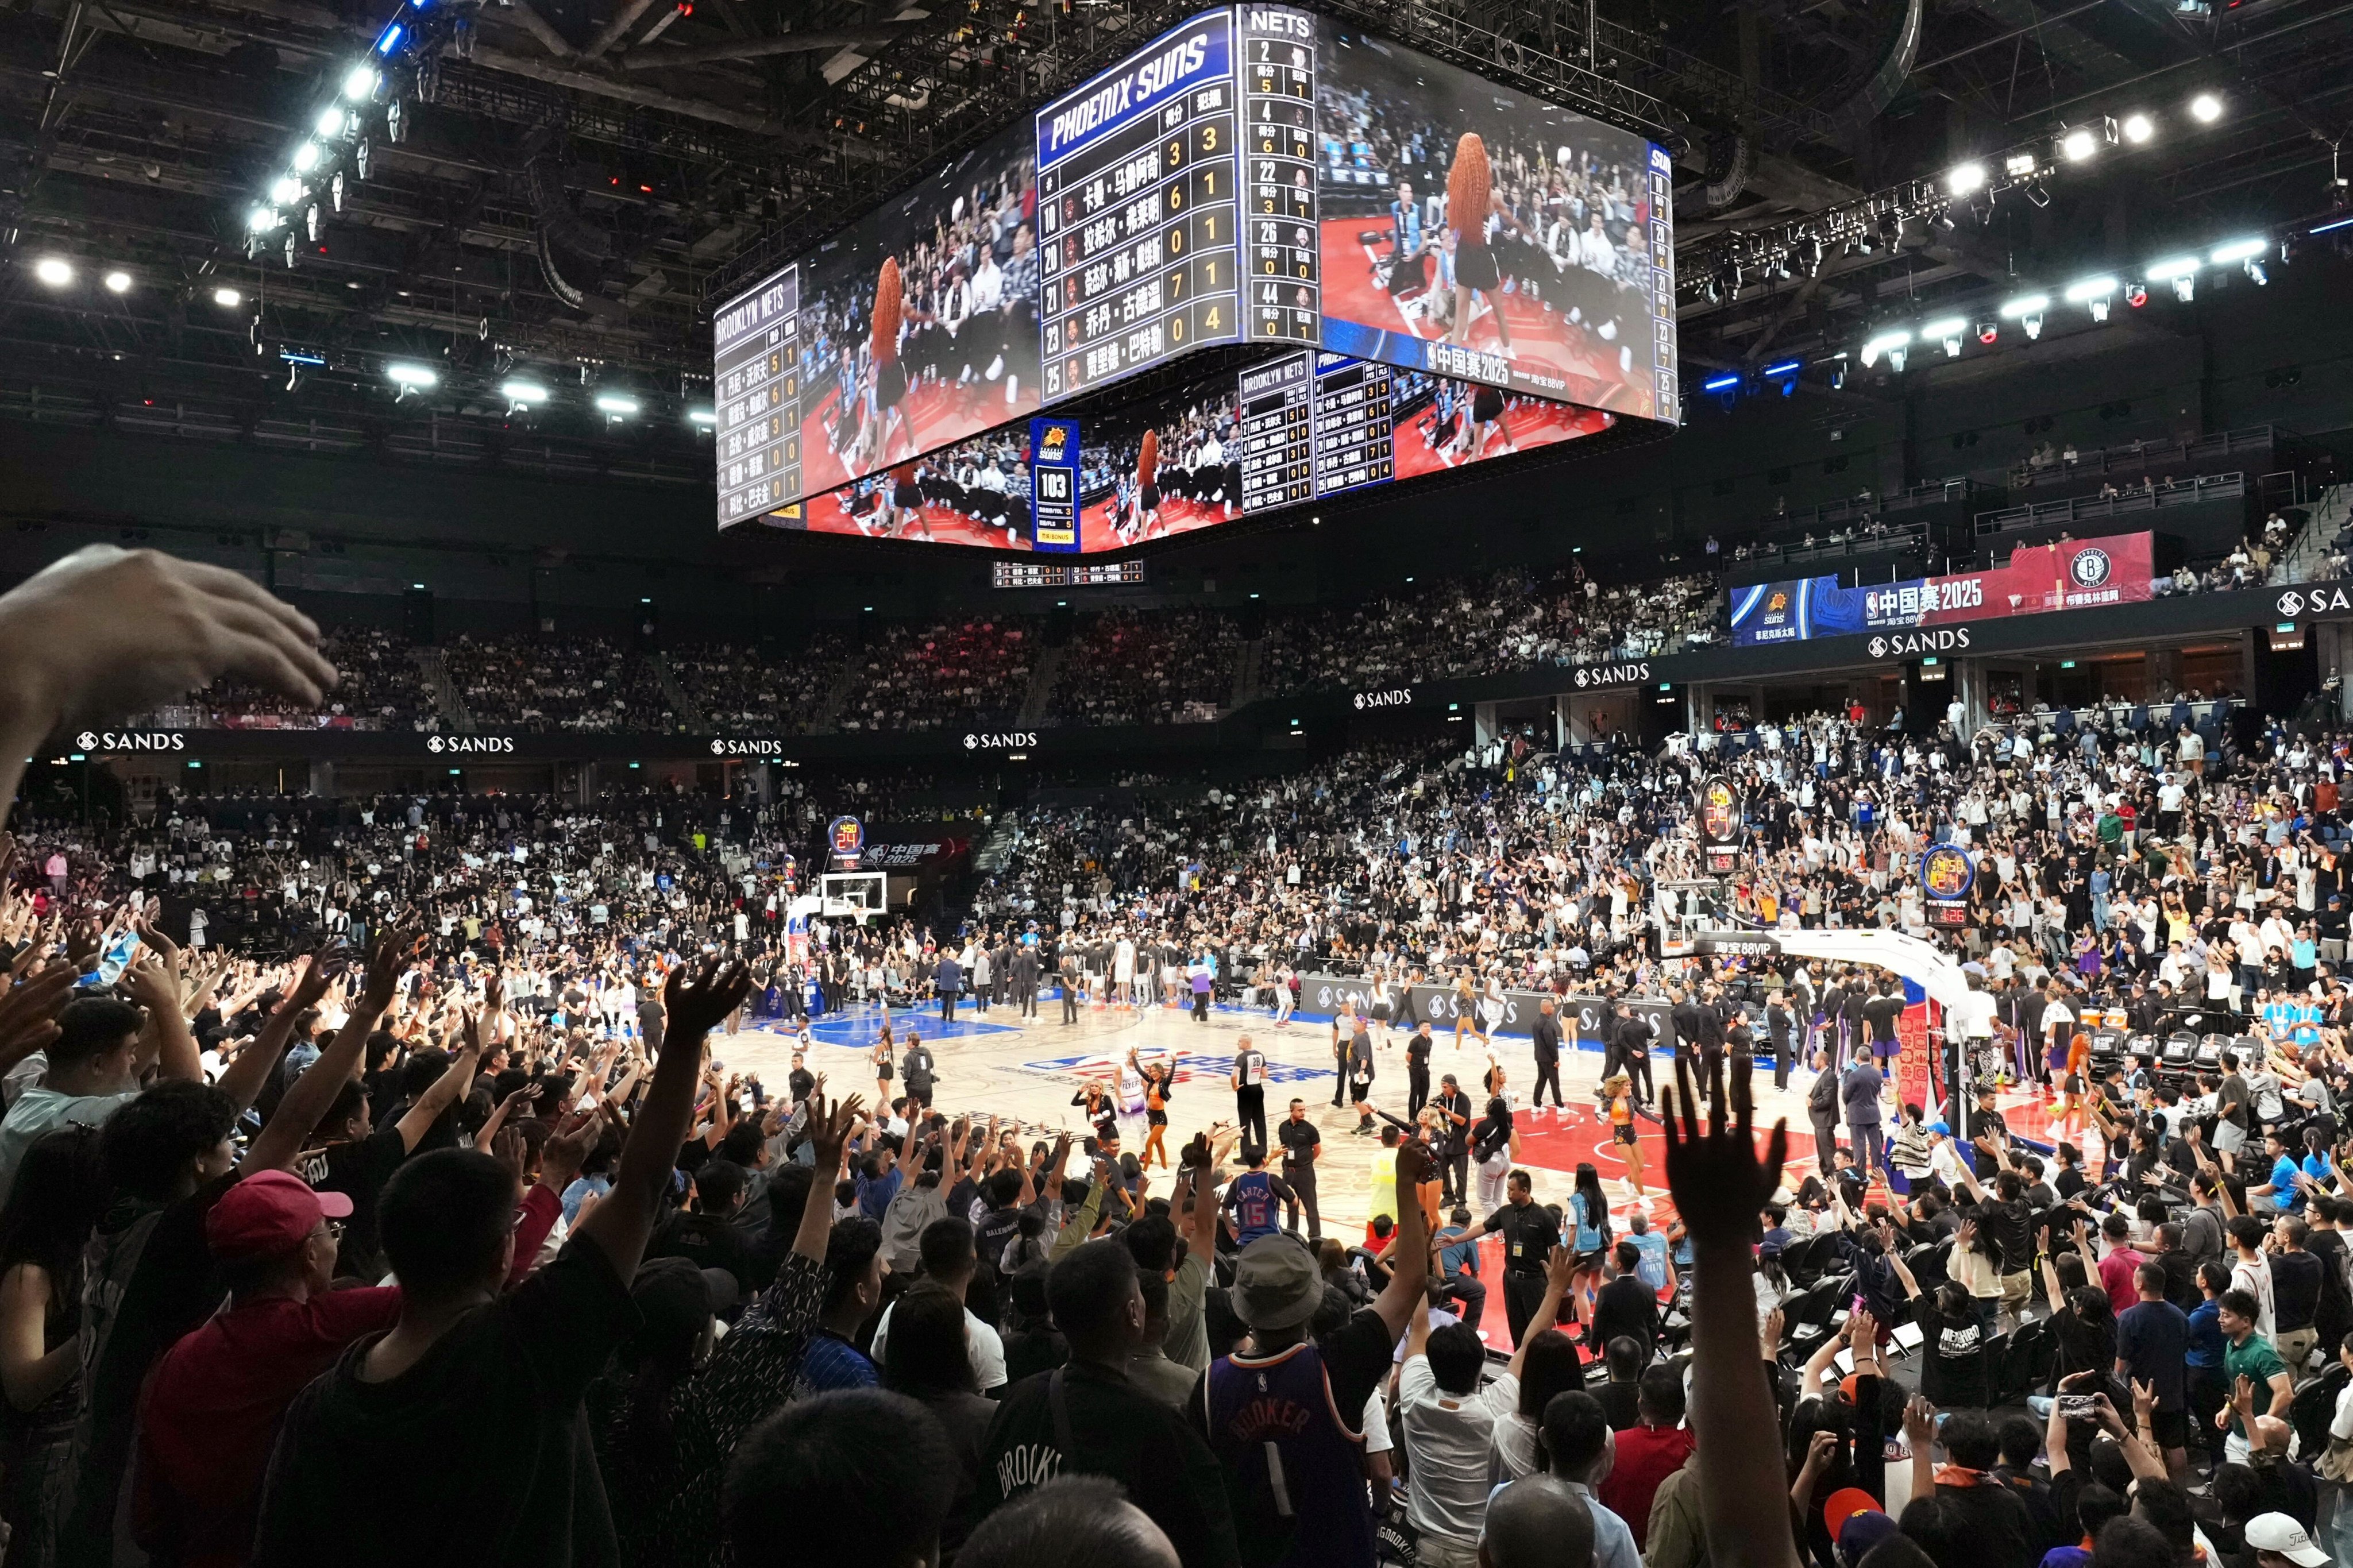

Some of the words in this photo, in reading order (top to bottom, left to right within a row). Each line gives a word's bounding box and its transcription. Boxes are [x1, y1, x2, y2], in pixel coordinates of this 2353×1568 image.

[1251, 11, 1310, 38] NETS
[1261, 41, 1270, 62] 2
[1257, 65, 1275, 78] 得分
[1292, 66, 1307, 82] 犯规
[1051, 76, 1132, 151] PHOENIX
[1136, 33, 1208, 103] SUNS
[1262, 79, 1271, 92] 5
[1297, 84, 1303, 98] 1
[1165, 104, 1184, 129] 得分
[1197, 88, 1222, 110] 犯规
[1262, 101, 1271, 122] 4
[1259, 126, 1276, 137] 得分
[1263, 139, 1272, 153] 6
[1297, 144, 1305, 158] 0
[1044, 204, 1056, 231] 10
[1169, 142, 1181, 166] 3
[1202, 126, 1217, 152] 3
[1260, 161, 1276, 183] 22
[1046, 177, 1053, 192] #
[1260, 186, 1277, 198] 得分
[1264, 200, 1273, 214] 3
[1299, 204, 1305, 218] 1
[1657, 207, 1663, 219] 3
[1044, 244, 1058, 272] 20
[1170, 186, 1181, 208] 6
[1203, 172, 1215, 195] 1
[1261, 222, 1277, 244] 26
[1261, 248, 1279, 260] 得分
[1659, 257, 1665, 268] 6
[1046, 284, 1057, 312] 21
[1171, 229, 1182, 254] 0
[1204, 217, 1216, 240] 1
[1265, 261, 1275, 275] 0
[1299, 265, 1307, 279] 0
[1658, 274, 1665, 292] 21
[1262, 283, 1278, 305] 44
[716, 299, 758, 345] BROOKLYN
[761, 283, 784, 319] NETS
[1046, 323, 1060, 352] 23
[1171, 273, 1183, 299] 7
[1205, 262, 1217, 286] 1
[1262, 308, 1279, 320] 得分
[1661, 306, 1667, 318] 0
[1266, 322, 1276, 336] 0
[1301, 326, 1307, 339] 1
[1660, 323, 1668, 342] 23
[1047, 365, 1060, 393] 25
[1172, 318, 1183, 342] 0
[1205, 306, 1220, 330] 4
[772, 355, 778, 372] 5
[787, 347, 792, 364] 1
[1662, 356, 1668, 367] 7
[1244, 369, 1281, 394] BROOKLYN
[1284, 360, 1303, 380] NETS
[1661, 373, 1670, 392] 25
[772, 387, 778, 403] 6
[788, 378, 794, 396] 0
[1368, 387, 1374, 396] 3
[1380, 383, 1386, 392] 3
[1290, 411, 1295, 420] 5
[1301, 407, 1306, 417] 1
[1369, 407, 1374, 416] 6
[1382, 403, 1386, 413] 1
[1664, 405, 1669, 417] 0
[773, 418, 779, 434] 3
[788, 411, 793, 427] 1
[1370, 427, 1375, 437] 0
[1382, 423, 1387, 433] 1
[1290, 430, 1295, 440] 6
[1301, 427, 1306, 437] 0
[773, 449, 780, 466] 0
[789, 442, 795, 459] 0
[1243, 461, 1249, 472] 22
[1291, 449, 1295, 459] 3
[1302, 446, 1307, 456] 1
[1370, 447, 1375, 457] 7
[1383, 444, 1387, 454] 1
[1291, 469, 1297, 478] 0
[1302, 465, 1307, 475] 0
[1371, 468, 1376, 477] 0
[1383, 464, 1389, 474] 4
[774, 480, 780, 497] 0
[789, 474, 794, 491] 1
[1042, 473, 1066, 499] 103
[1292, 488, 1297, 497] 0
[1303, 485, 1308, 495] 1
[2075, 550, 2105, 563] BROOKLYN
[2086, 559, 2095, 578] B
[2066, 589, 2119, 606] 布鲁克林篮网
[1887, 613, 1926, 626] 淘宝88VIP
[1756, 627, 1795, 640] 菲尼克斯太阳
[1891, 628, 1970, 654] SANDS
[1591, 663, 1649, 685] SANDS
[1367, 689, 1411, 708] SANDS
[103, 732, 184, 751] SANDS
[448, 736, 514, 752] SANDS
[727, 740, 782, 754] SANDS
[981, 732, 1037, 748] SANDS
[840, 824, 857, 833] 4:50
[1706, 806, 1729, 833] 24
[837, 833, 855, 849] 24
[890, 843, 942, 855] 中国赛
[884, 855, 919, 863] 2025
[1937, 874, 1959, 891] 24
[1943, 909, 1965, 922] 1:26
[1714, 942, 1770, 955] 淘宝88VIP
[1236, 1186, 1270, 1203] CARTER
[1243, 1202, 1267, 1227] 15
[1263, 1441, 1293, 1516] 1
